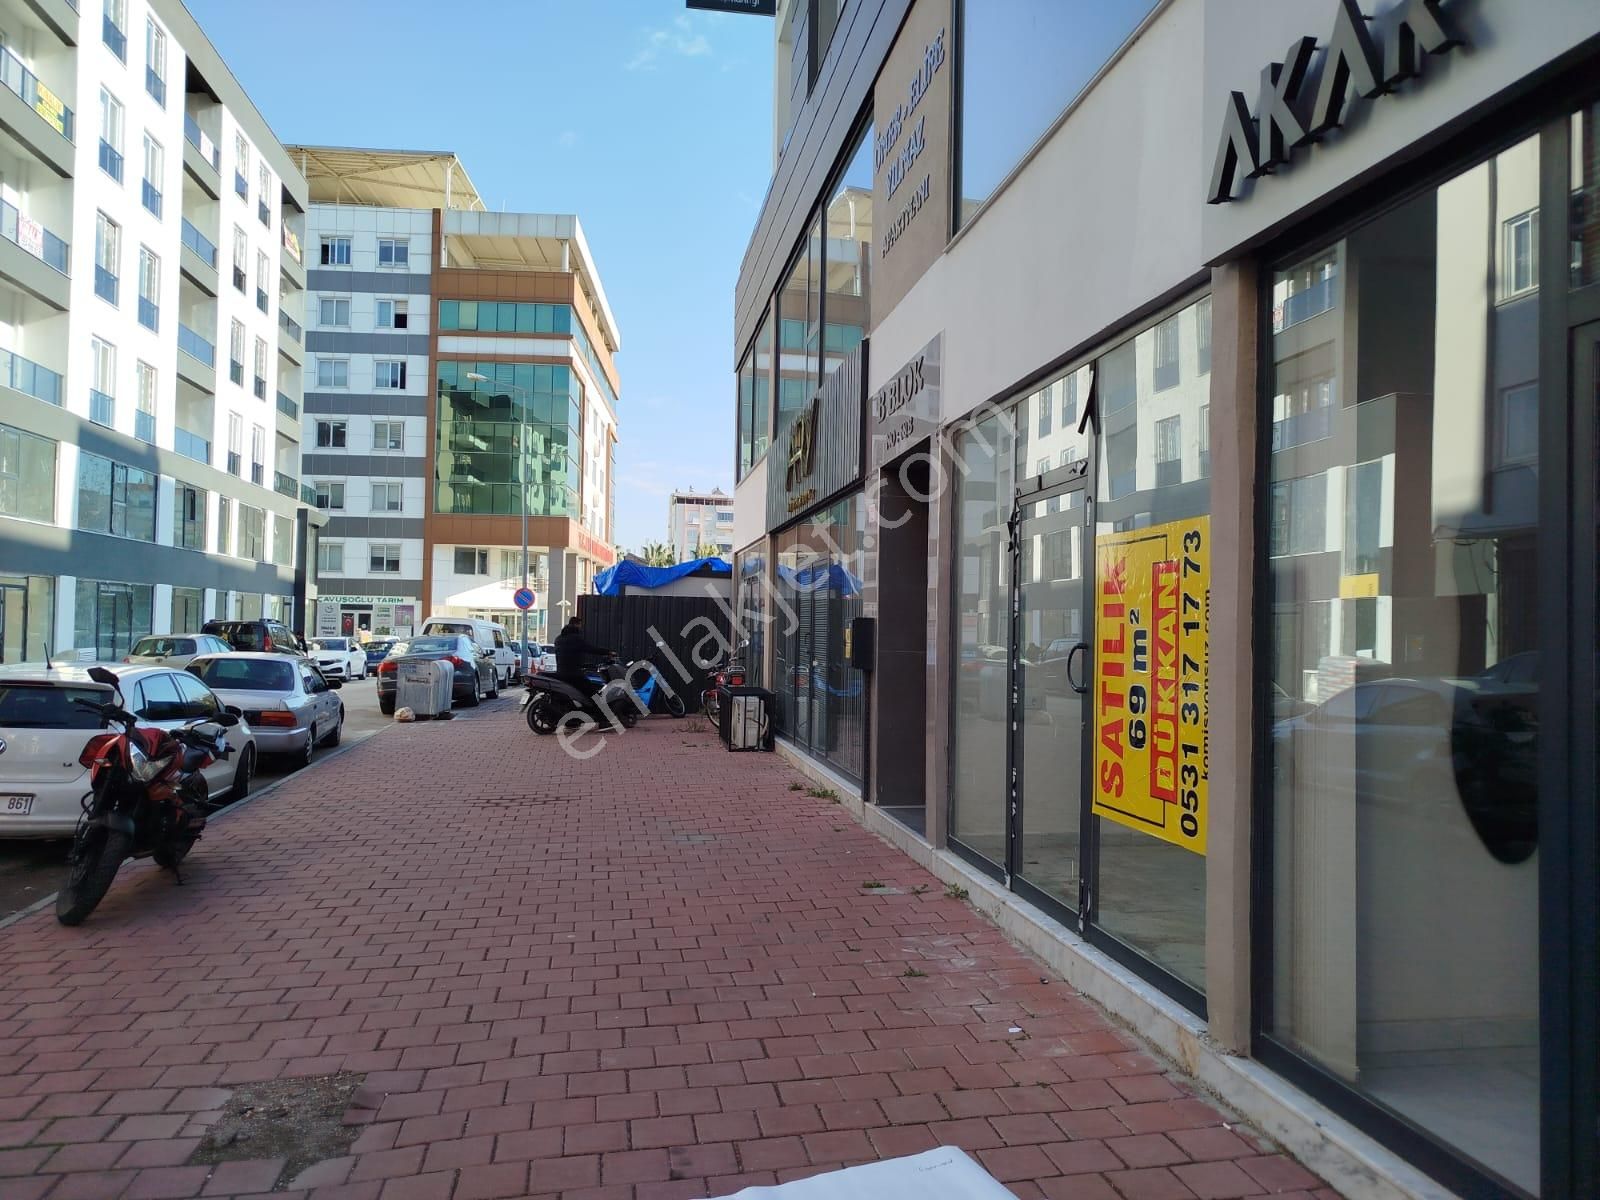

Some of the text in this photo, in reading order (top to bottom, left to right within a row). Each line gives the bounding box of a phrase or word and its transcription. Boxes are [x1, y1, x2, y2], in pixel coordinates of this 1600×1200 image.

[885, 114, 926, 201] YILMAZ
[877, 354, 925, 425] B BLOK
[1101, 555, 1127, 799] SATILIK
[1128, 684, 1147, 750] 69
[1153, 571, 1178, 793] DÜKKAN
[1180, 529, 1202, 838] 0531 317 17 73
[1200, 588, 1210, 781] komisyonsuzcom
[8, 797, 30, 810] 861
